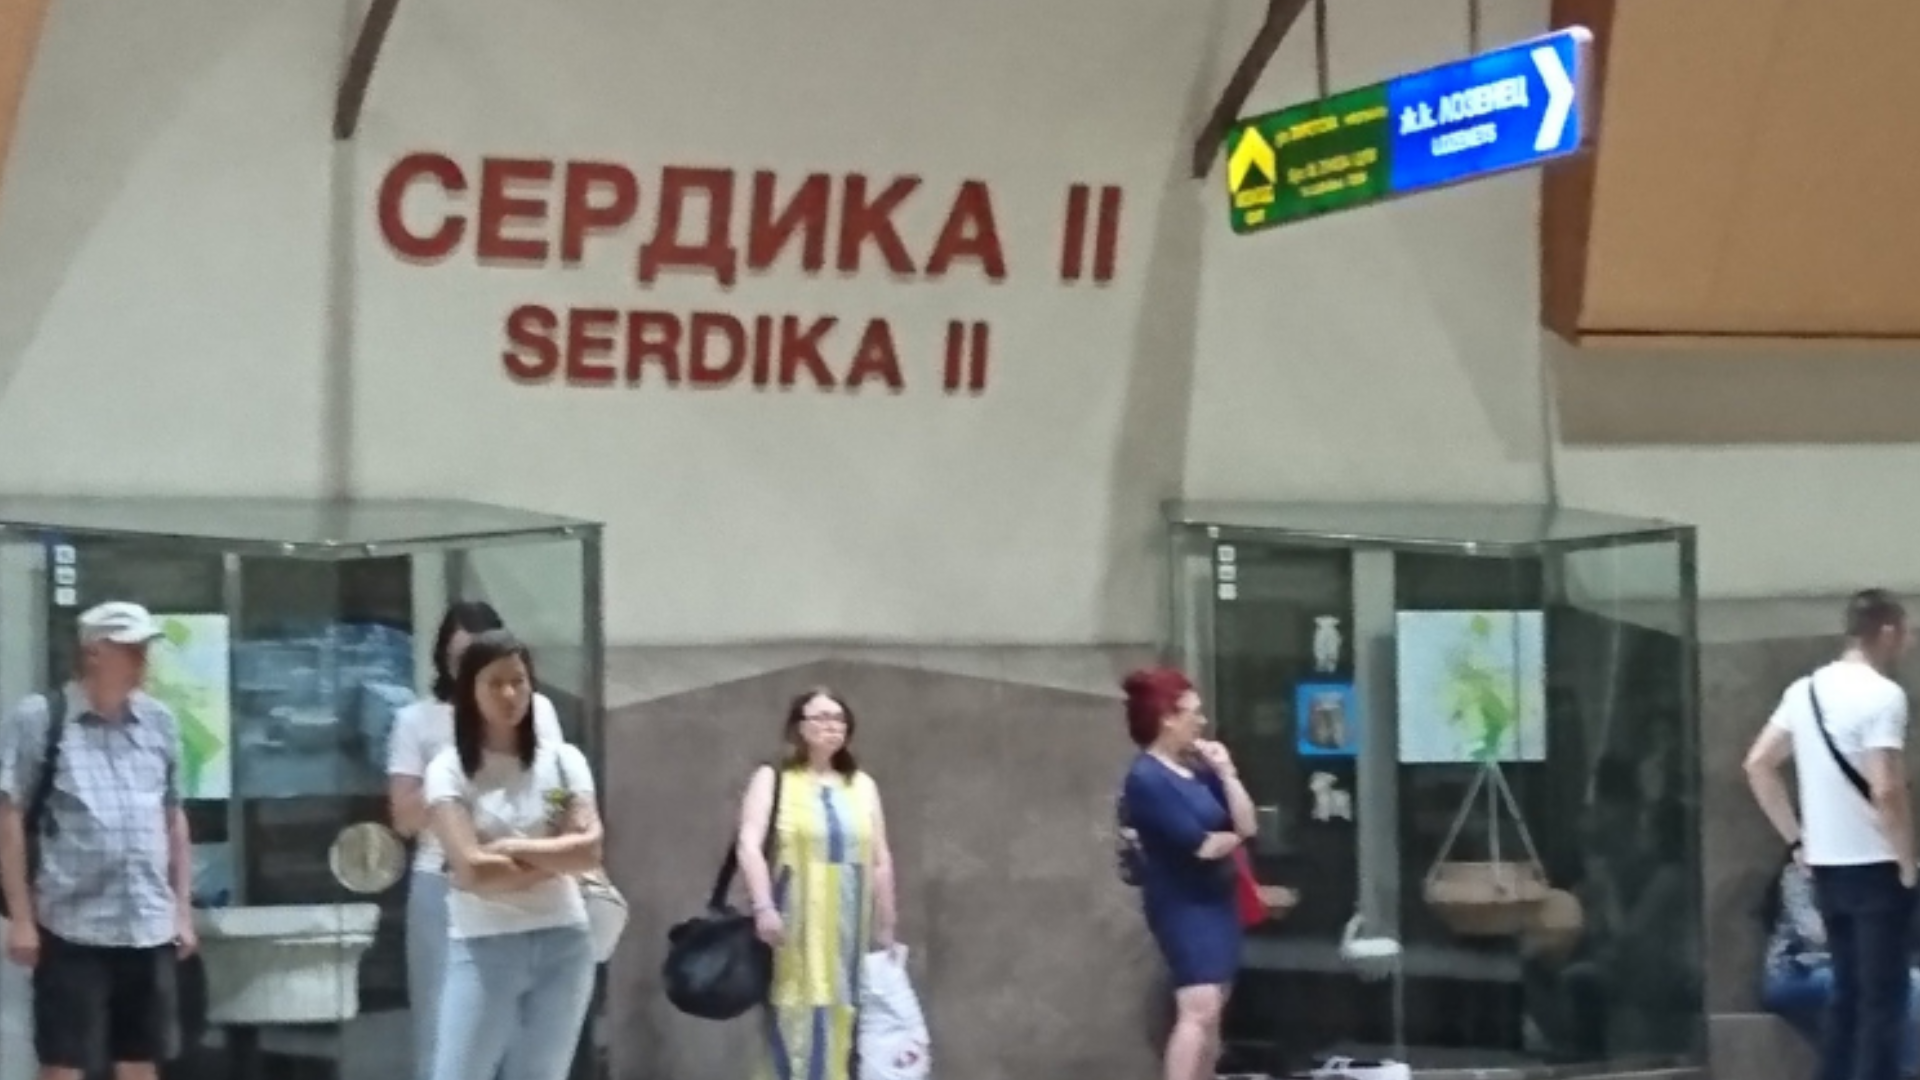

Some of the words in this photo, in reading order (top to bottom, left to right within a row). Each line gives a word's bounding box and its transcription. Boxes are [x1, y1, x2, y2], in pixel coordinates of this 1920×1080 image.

[378, 152, 1006, 285] СЕРДИКА
[1060, 183, 1122, 280] II
[502, 304, 903, 390] SERDIKA
[943, 319, 989, 391] II
